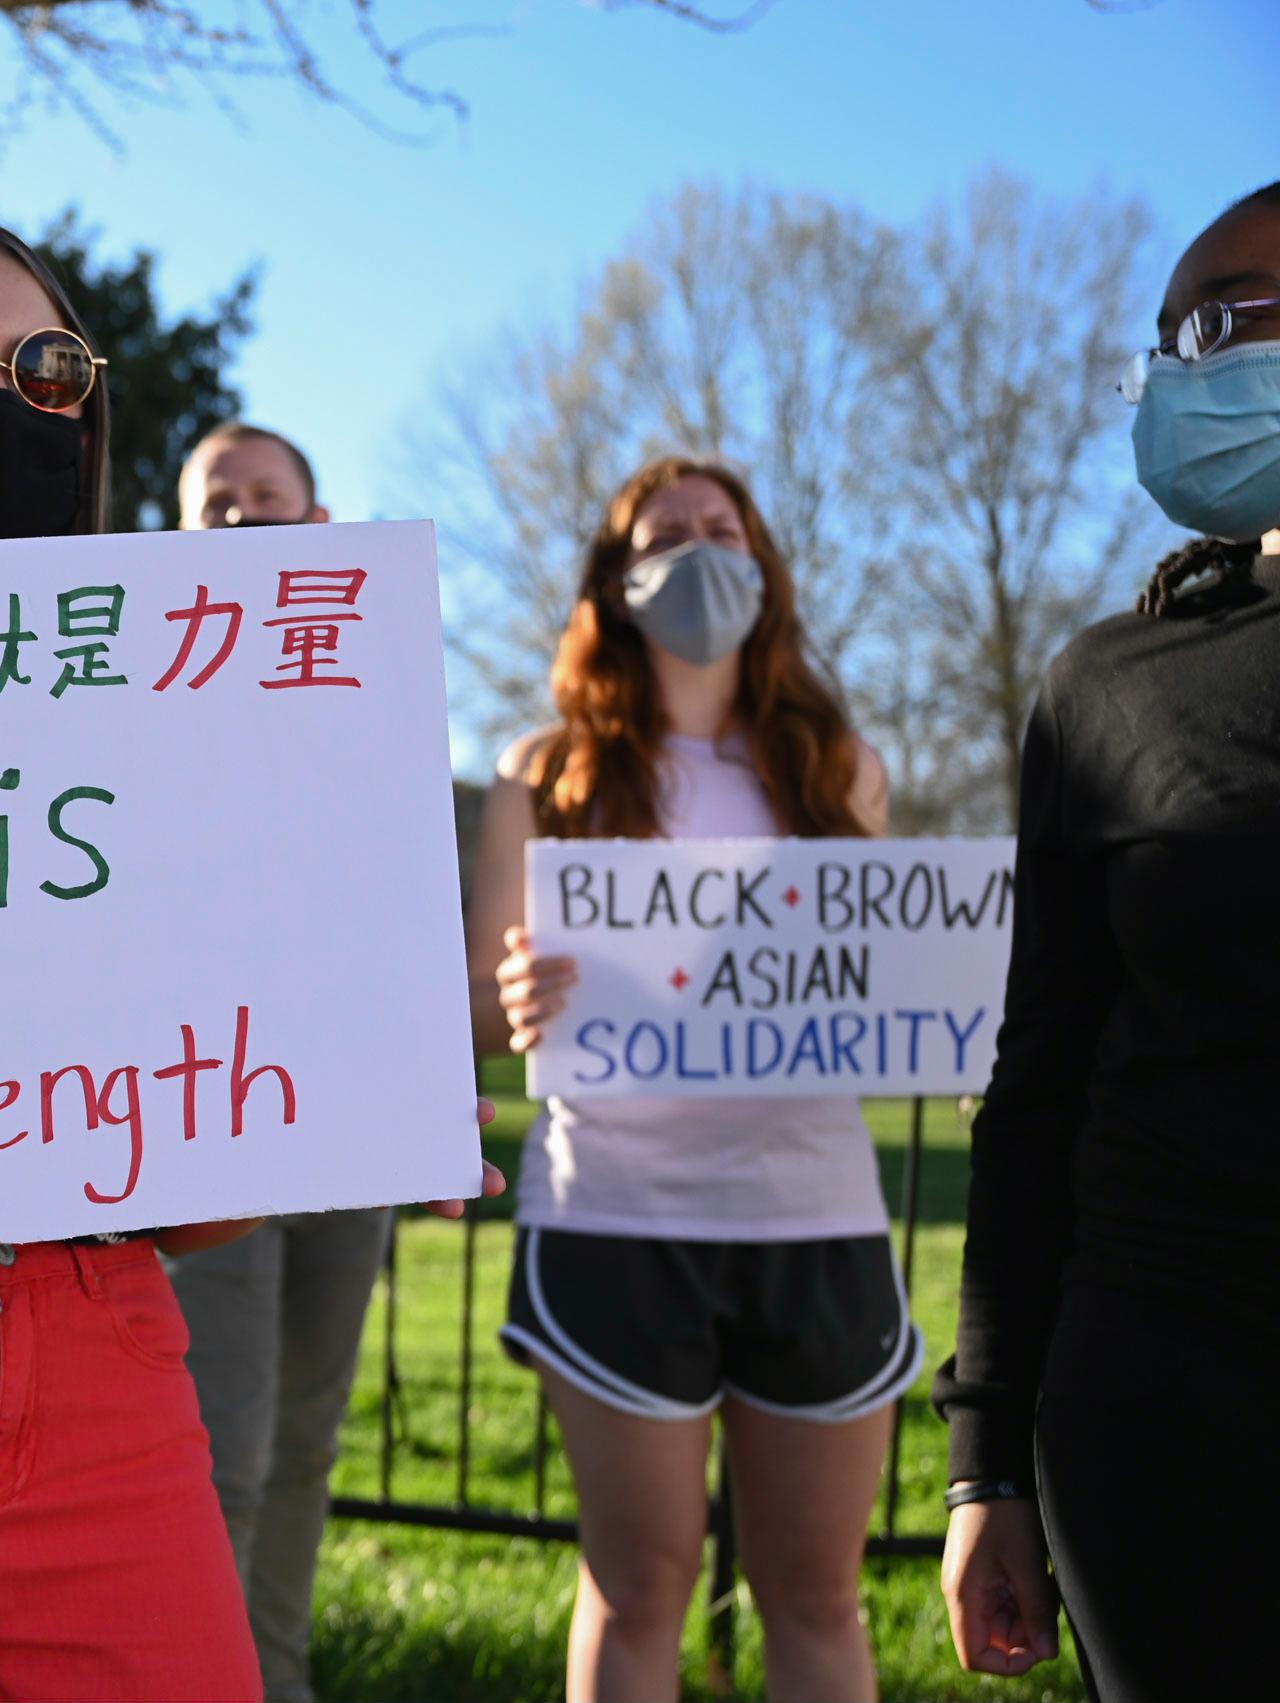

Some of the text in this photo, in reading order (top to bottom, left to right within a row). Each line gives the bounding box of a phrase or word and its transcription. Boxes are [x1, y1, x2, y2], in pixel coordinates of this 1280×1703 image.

[560, 863, 774, 931] BLACK
[701, 945, 871, 1011] ASIAN
[574, 1007, 987, 1084] SOLIDARITY
